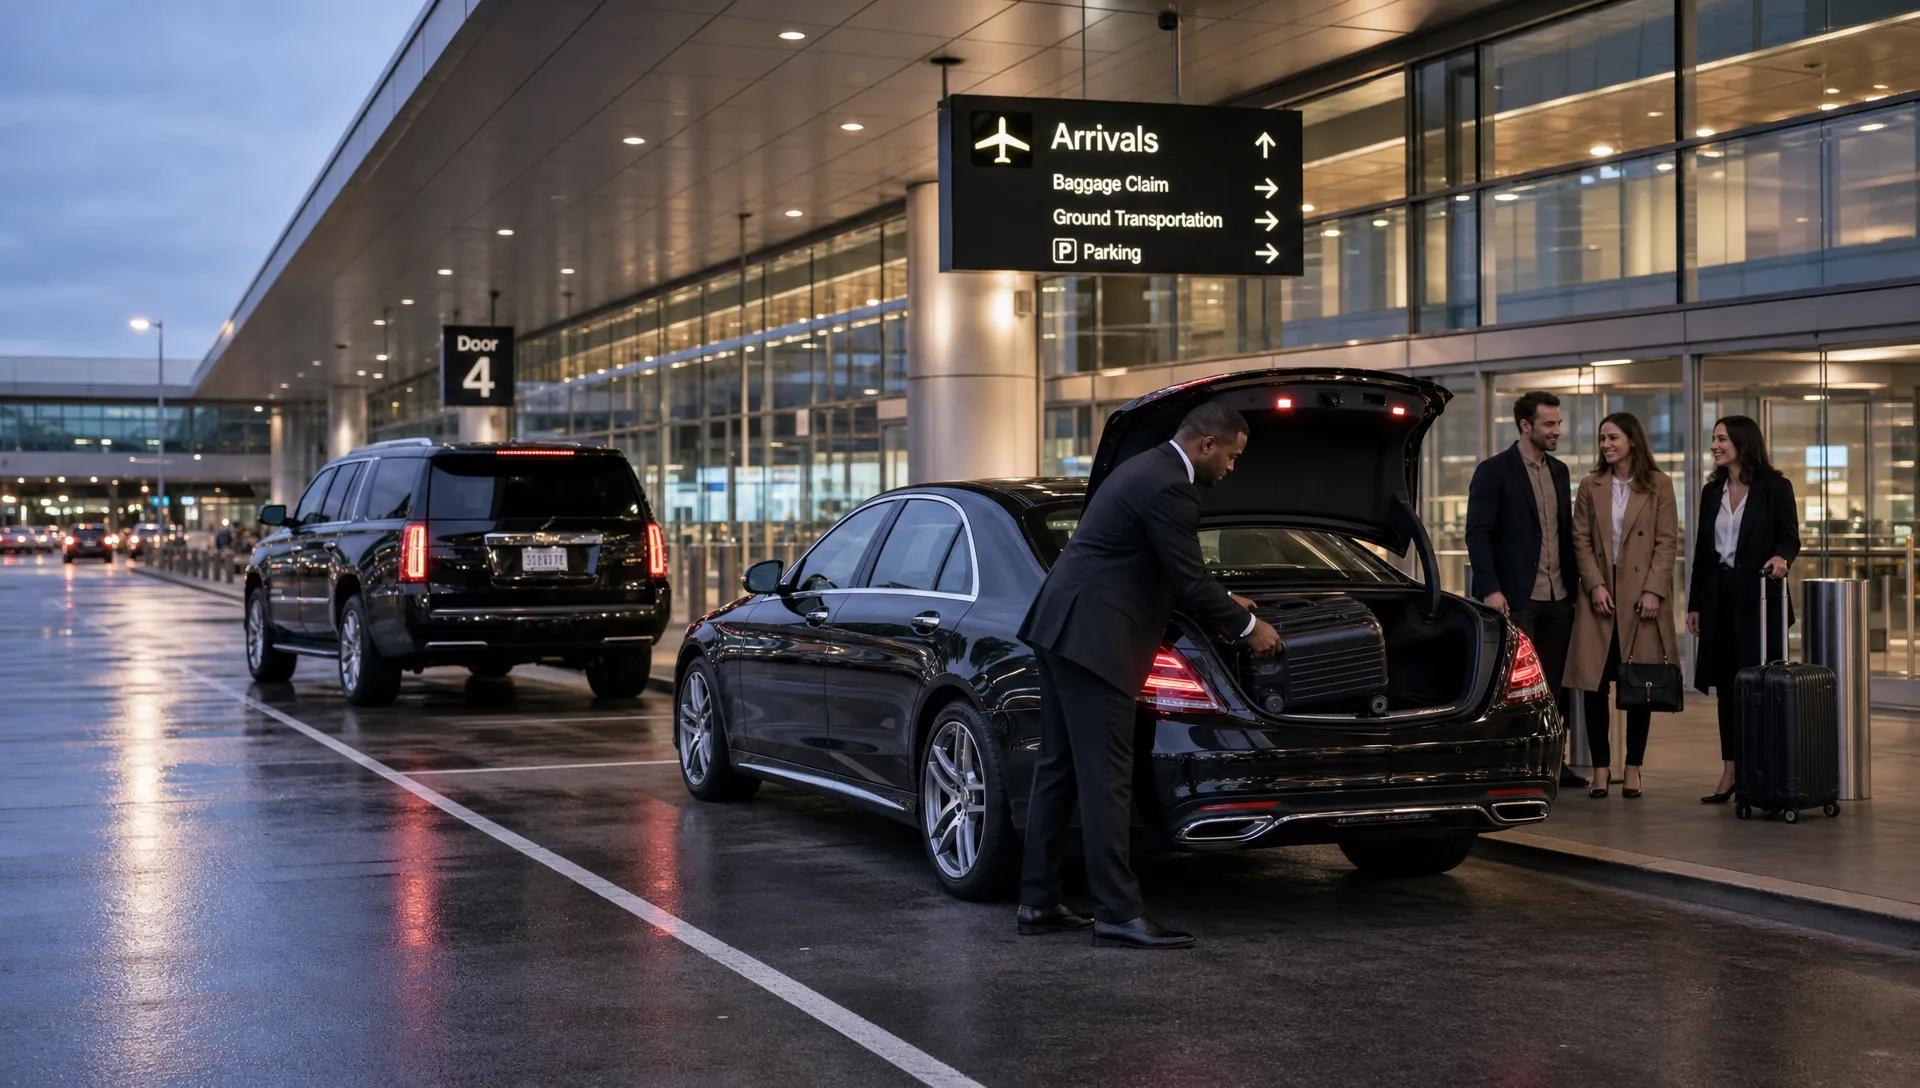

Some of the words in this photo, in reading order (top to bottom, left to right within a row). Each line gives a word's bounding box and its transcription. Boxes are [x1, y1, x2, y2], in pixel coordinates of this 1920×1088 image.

[1051, 122, 1159, 154] Arrivals
[1053, 173, 1121, 195] Baggage
[1126, 175, 1169, 193] Claim
[1053, 208, 1111, 227] Ground
[1115, 209, 1223, 230] Transportation
[1058, 242, 1072, 259] P
[1083, 243, 1141, 264] Parking
[457, 335, 499, 352] Door
[462, 356, 496, 398] 4
